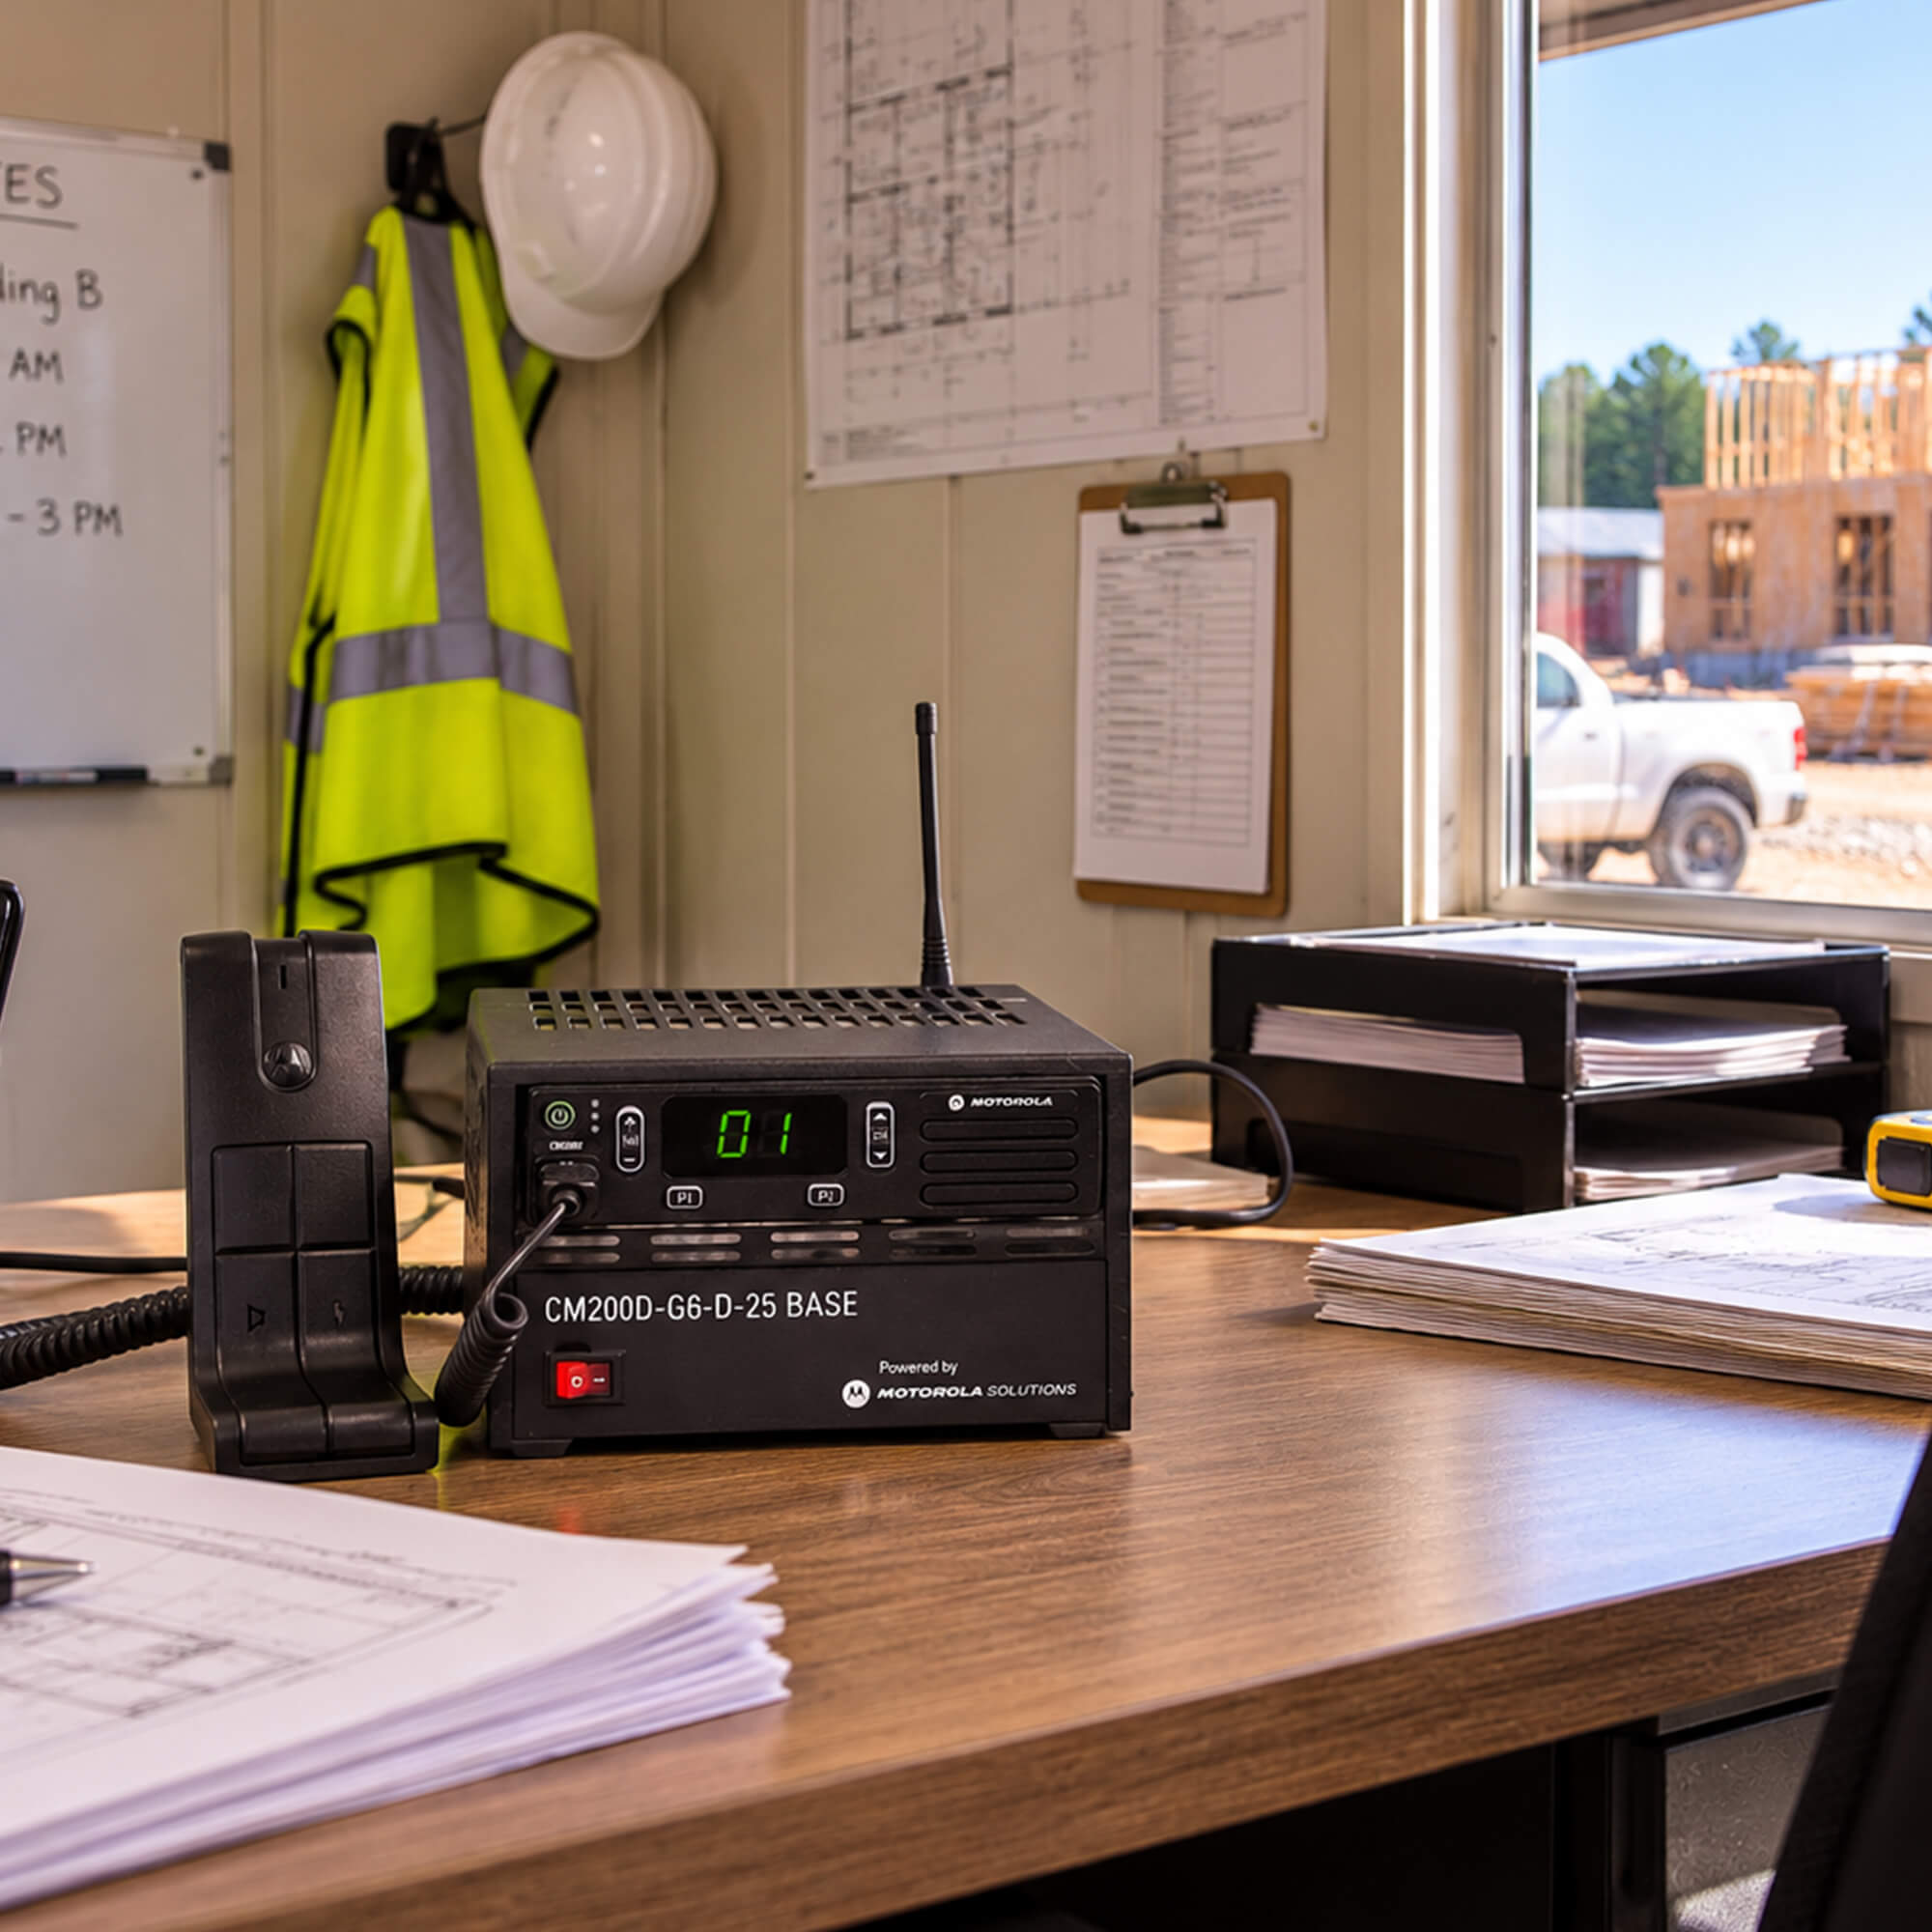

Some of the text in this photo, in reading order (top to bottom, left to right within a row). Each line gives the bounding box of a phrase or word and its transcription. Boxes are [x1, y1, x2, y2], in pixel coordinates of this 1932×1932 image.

[0, 161, 64, 210] ES
[75, 268, 103, 311] B
[8, 347, 65, 384] AM
[15, 421, 68, 458] PM
[36, 497, 61, 536] 3
[73, 499, 124, 538] PM
[970, 1095, 1054, 1108] MOTOROLA
[716, 1110, 792, 1158] 01
[545, 1291, 858, 1322] CM200D-G6-D-25 BASE
[878, 1359, 959, 1377] Powered by
[876, 1382, 1077, 1399] MOTOROLA SOLUTIONS
